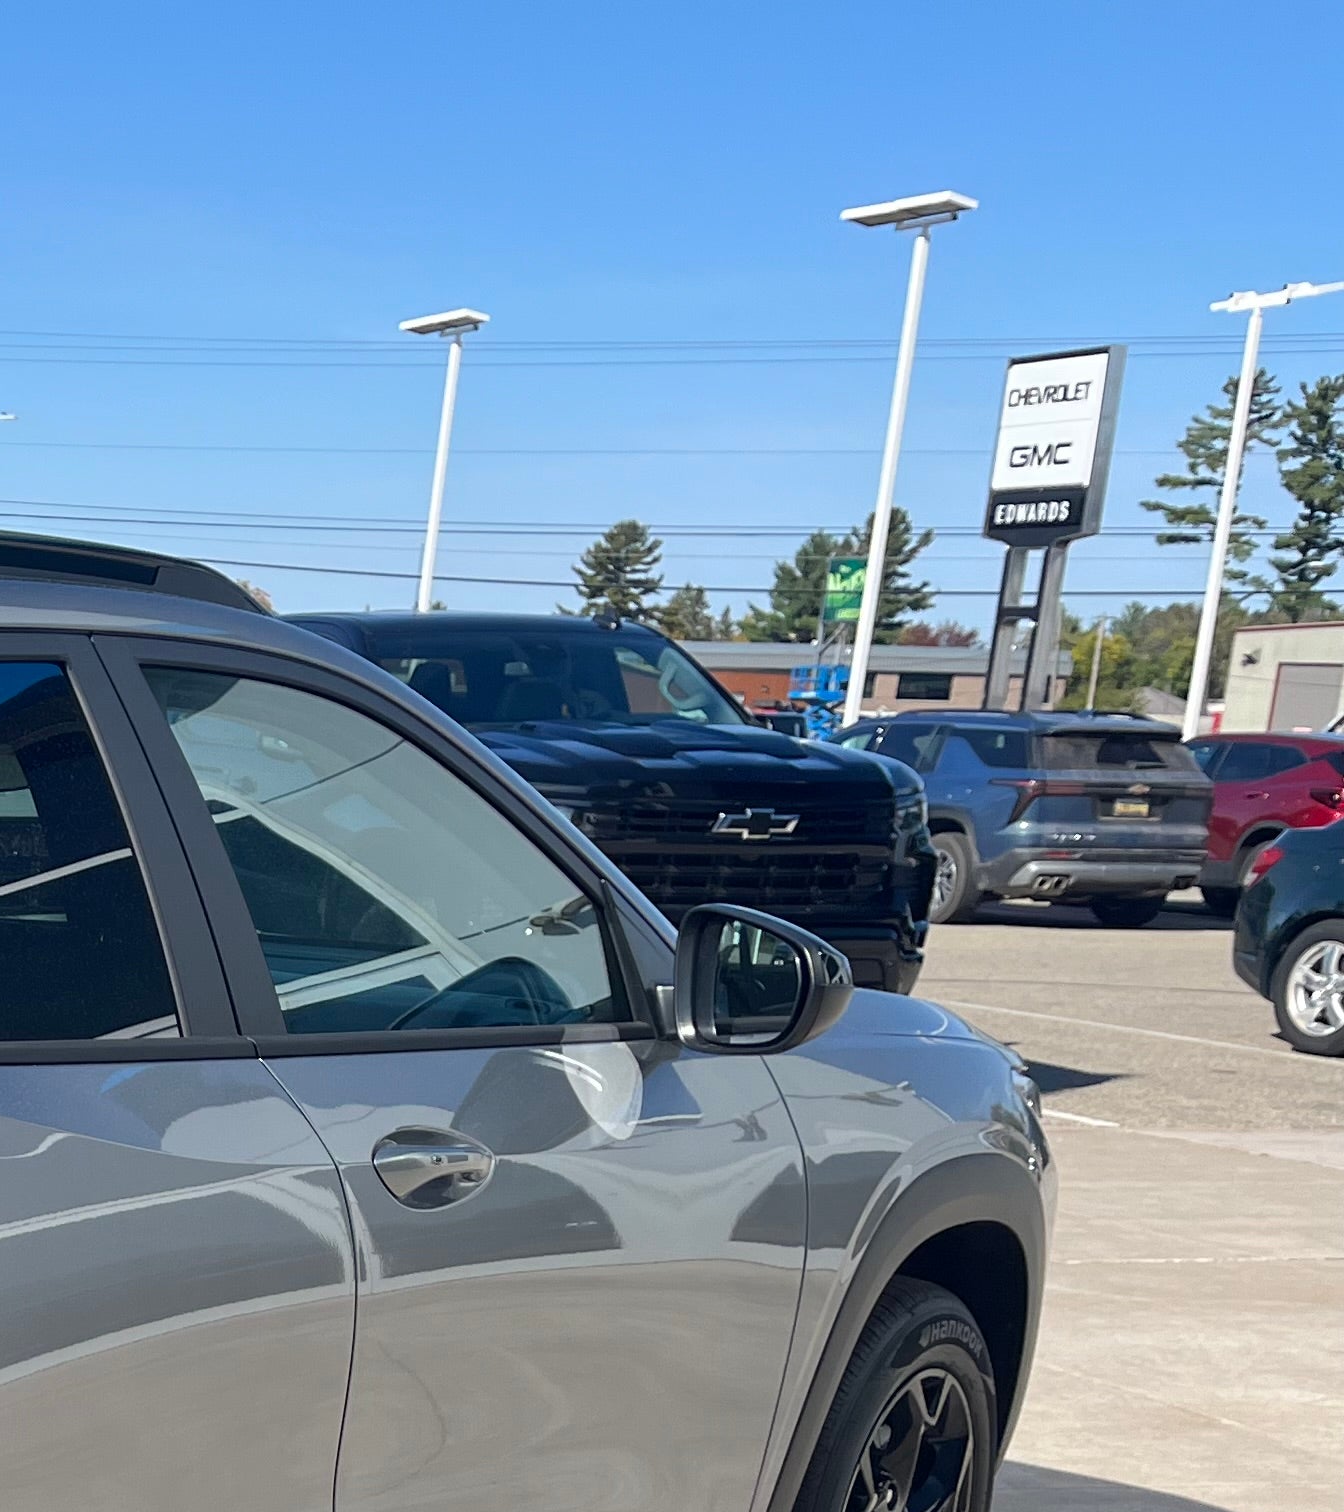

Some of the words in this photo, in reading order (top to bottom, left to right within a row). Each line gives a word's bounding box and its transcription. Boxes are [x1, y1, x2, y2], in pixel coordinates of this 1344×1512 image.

[1008, 380, 1092, 408] CHEVROLET
[1009, 442, 1072, 468] GMC
[993, 500, 1071, 525] EDWARDS
